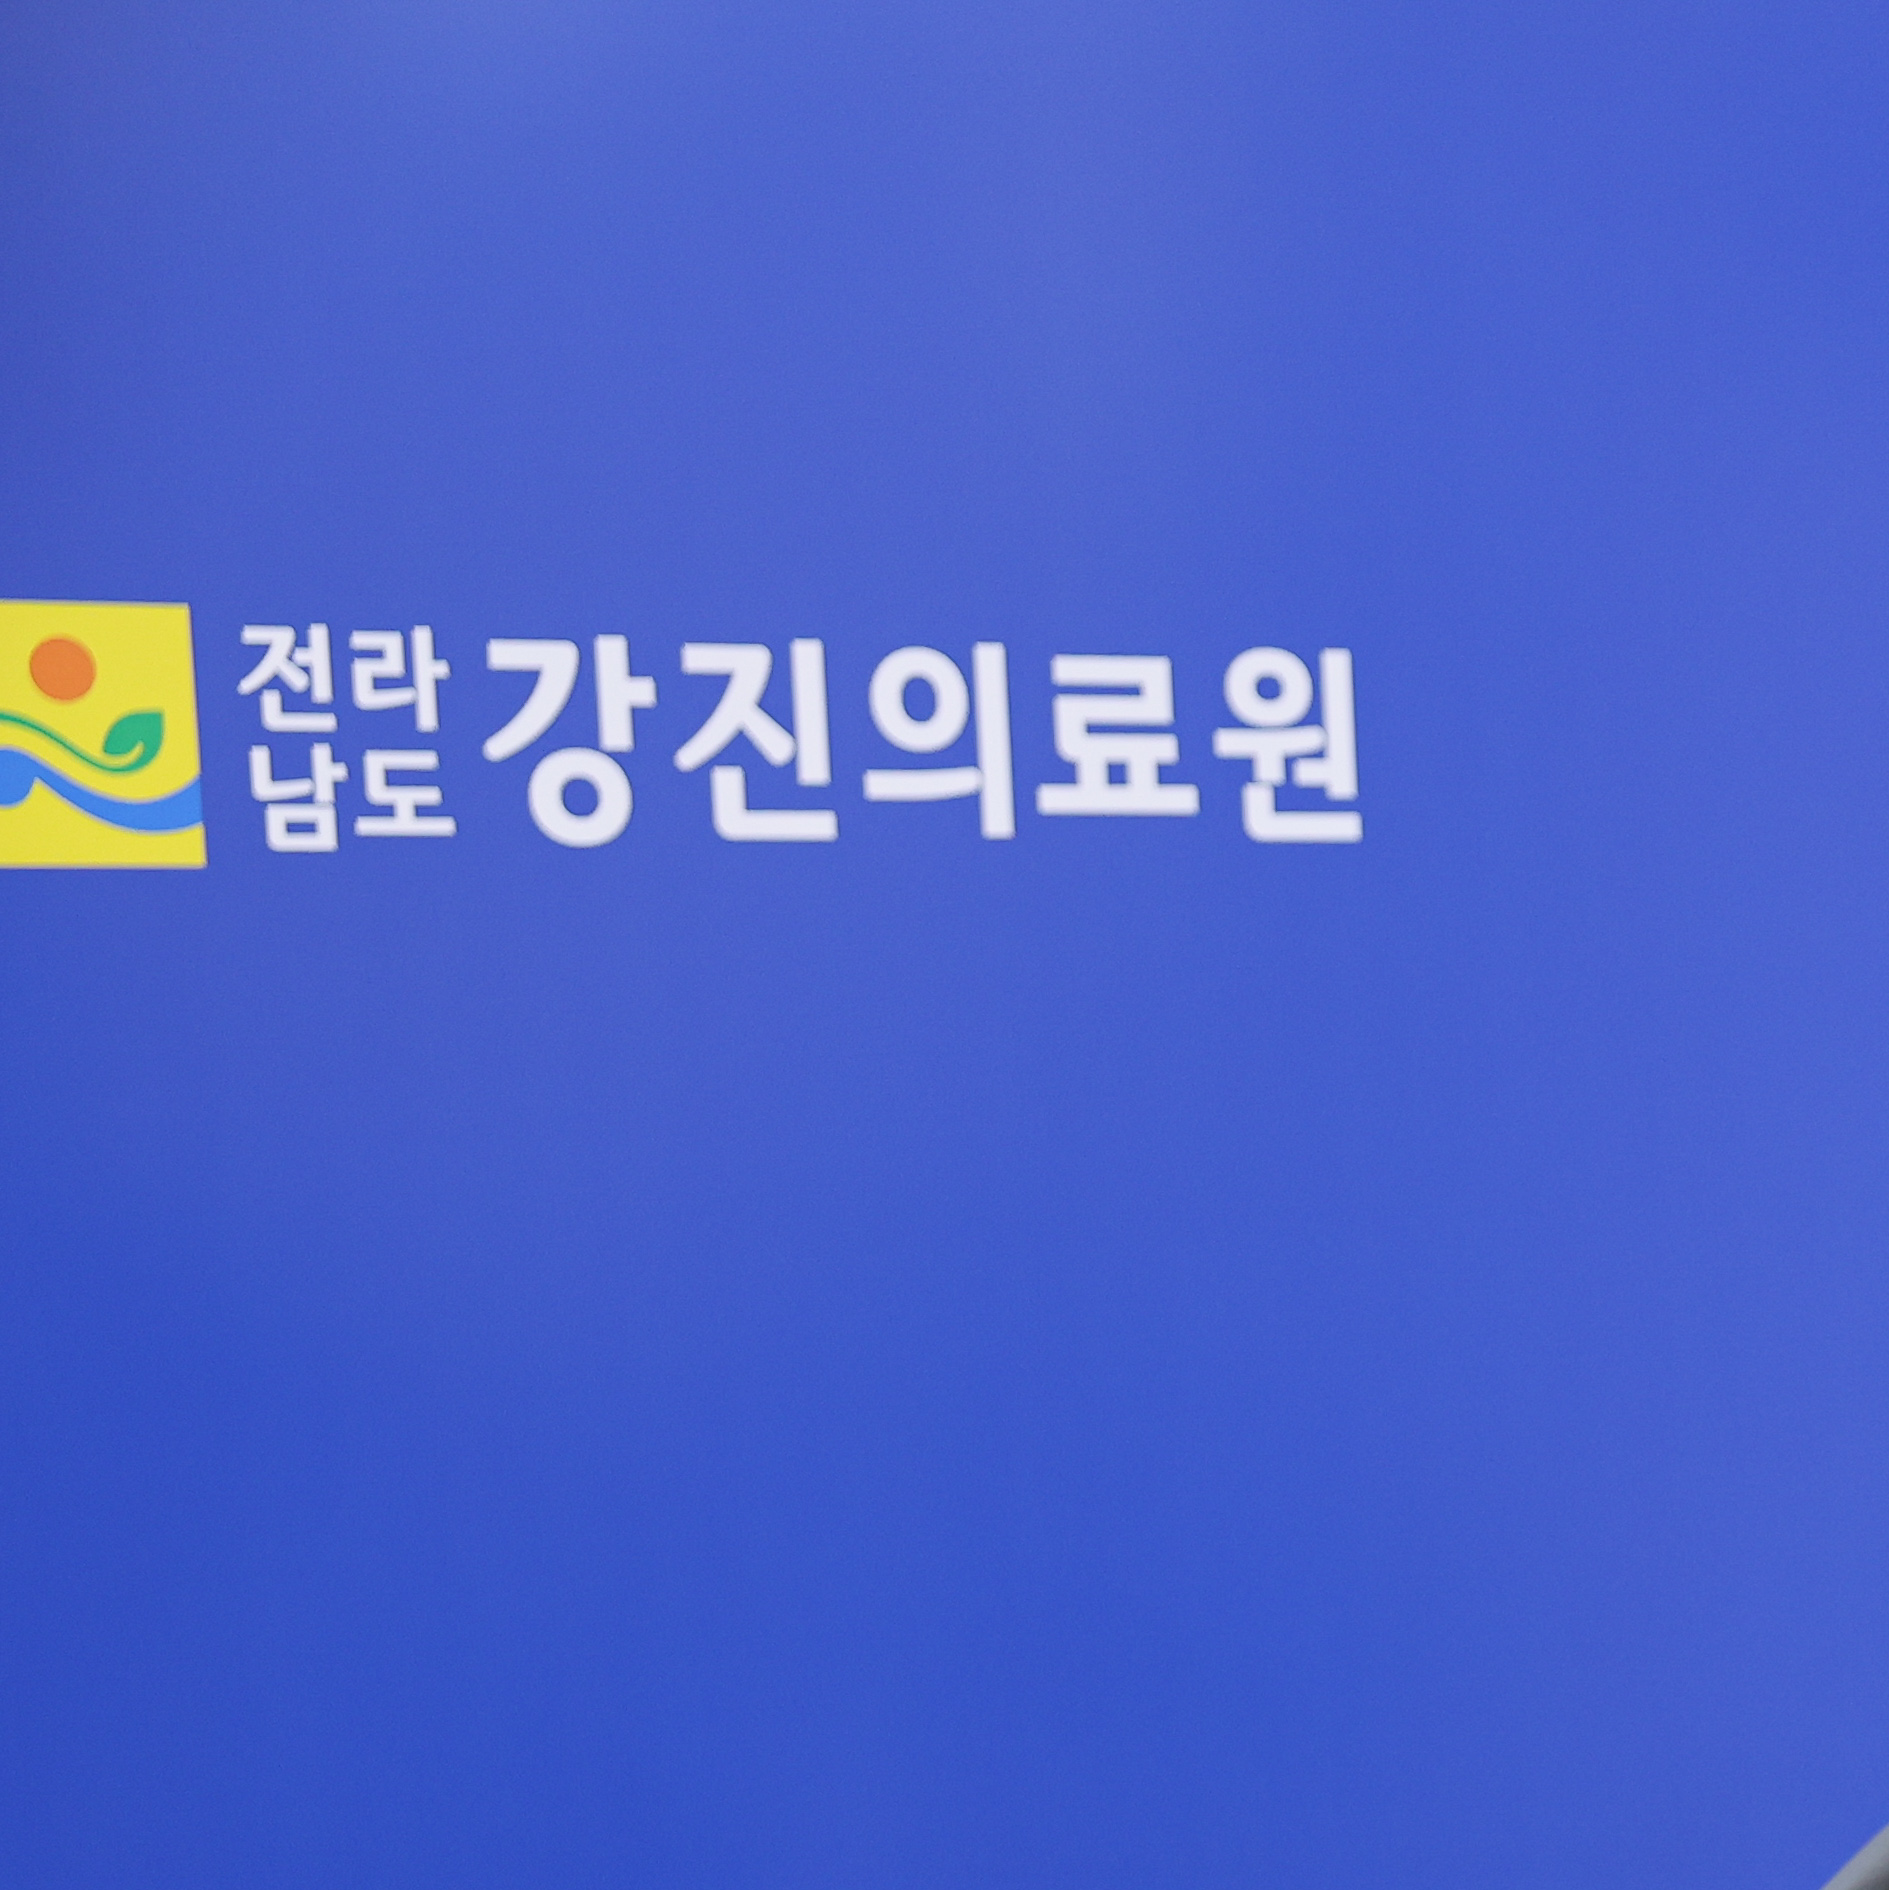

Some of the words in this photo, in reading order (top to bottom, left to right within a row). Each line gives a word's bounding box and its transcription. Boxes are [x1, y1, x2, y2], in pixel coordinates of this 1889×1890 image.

[237, 621, 451, 734] 전라
[481, 631, 1366, 850] 강진의료원
[247, 741, 458, 855] 남도
